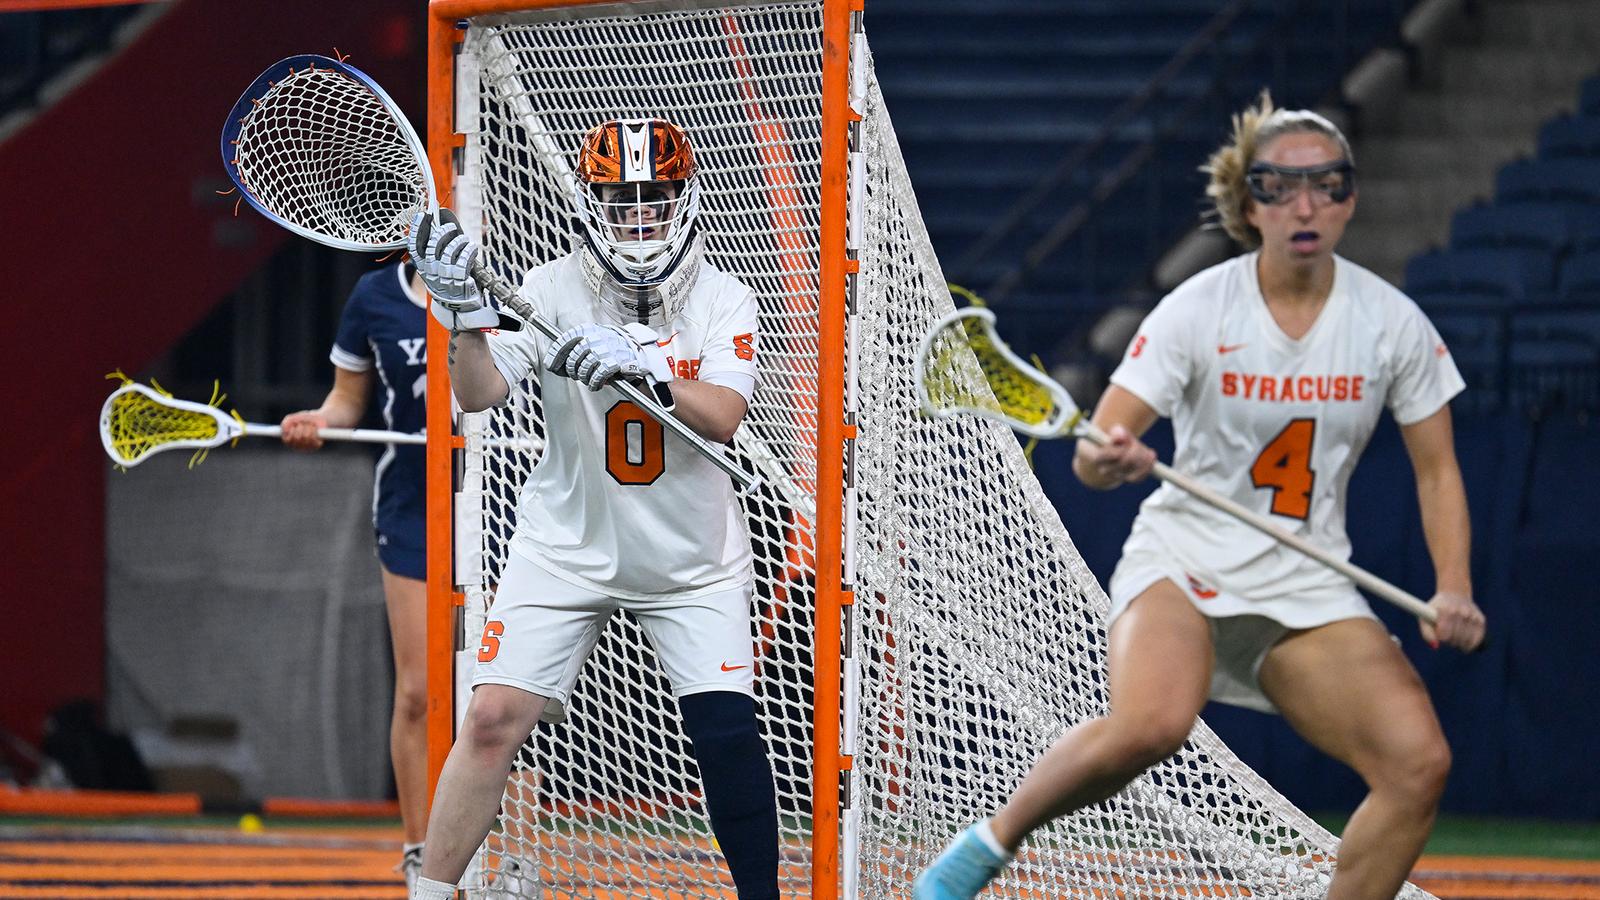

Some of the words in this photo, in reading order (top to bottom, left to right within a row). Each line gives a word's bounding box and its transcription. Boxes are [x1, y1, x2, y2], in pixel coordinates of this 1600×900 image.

[1221, 373, 1365, 402] SYRACUSE
[605, 399, 666, 486] 0
[1249, 417, 1316, 521] 4
[476, 620, 506, 665] S
